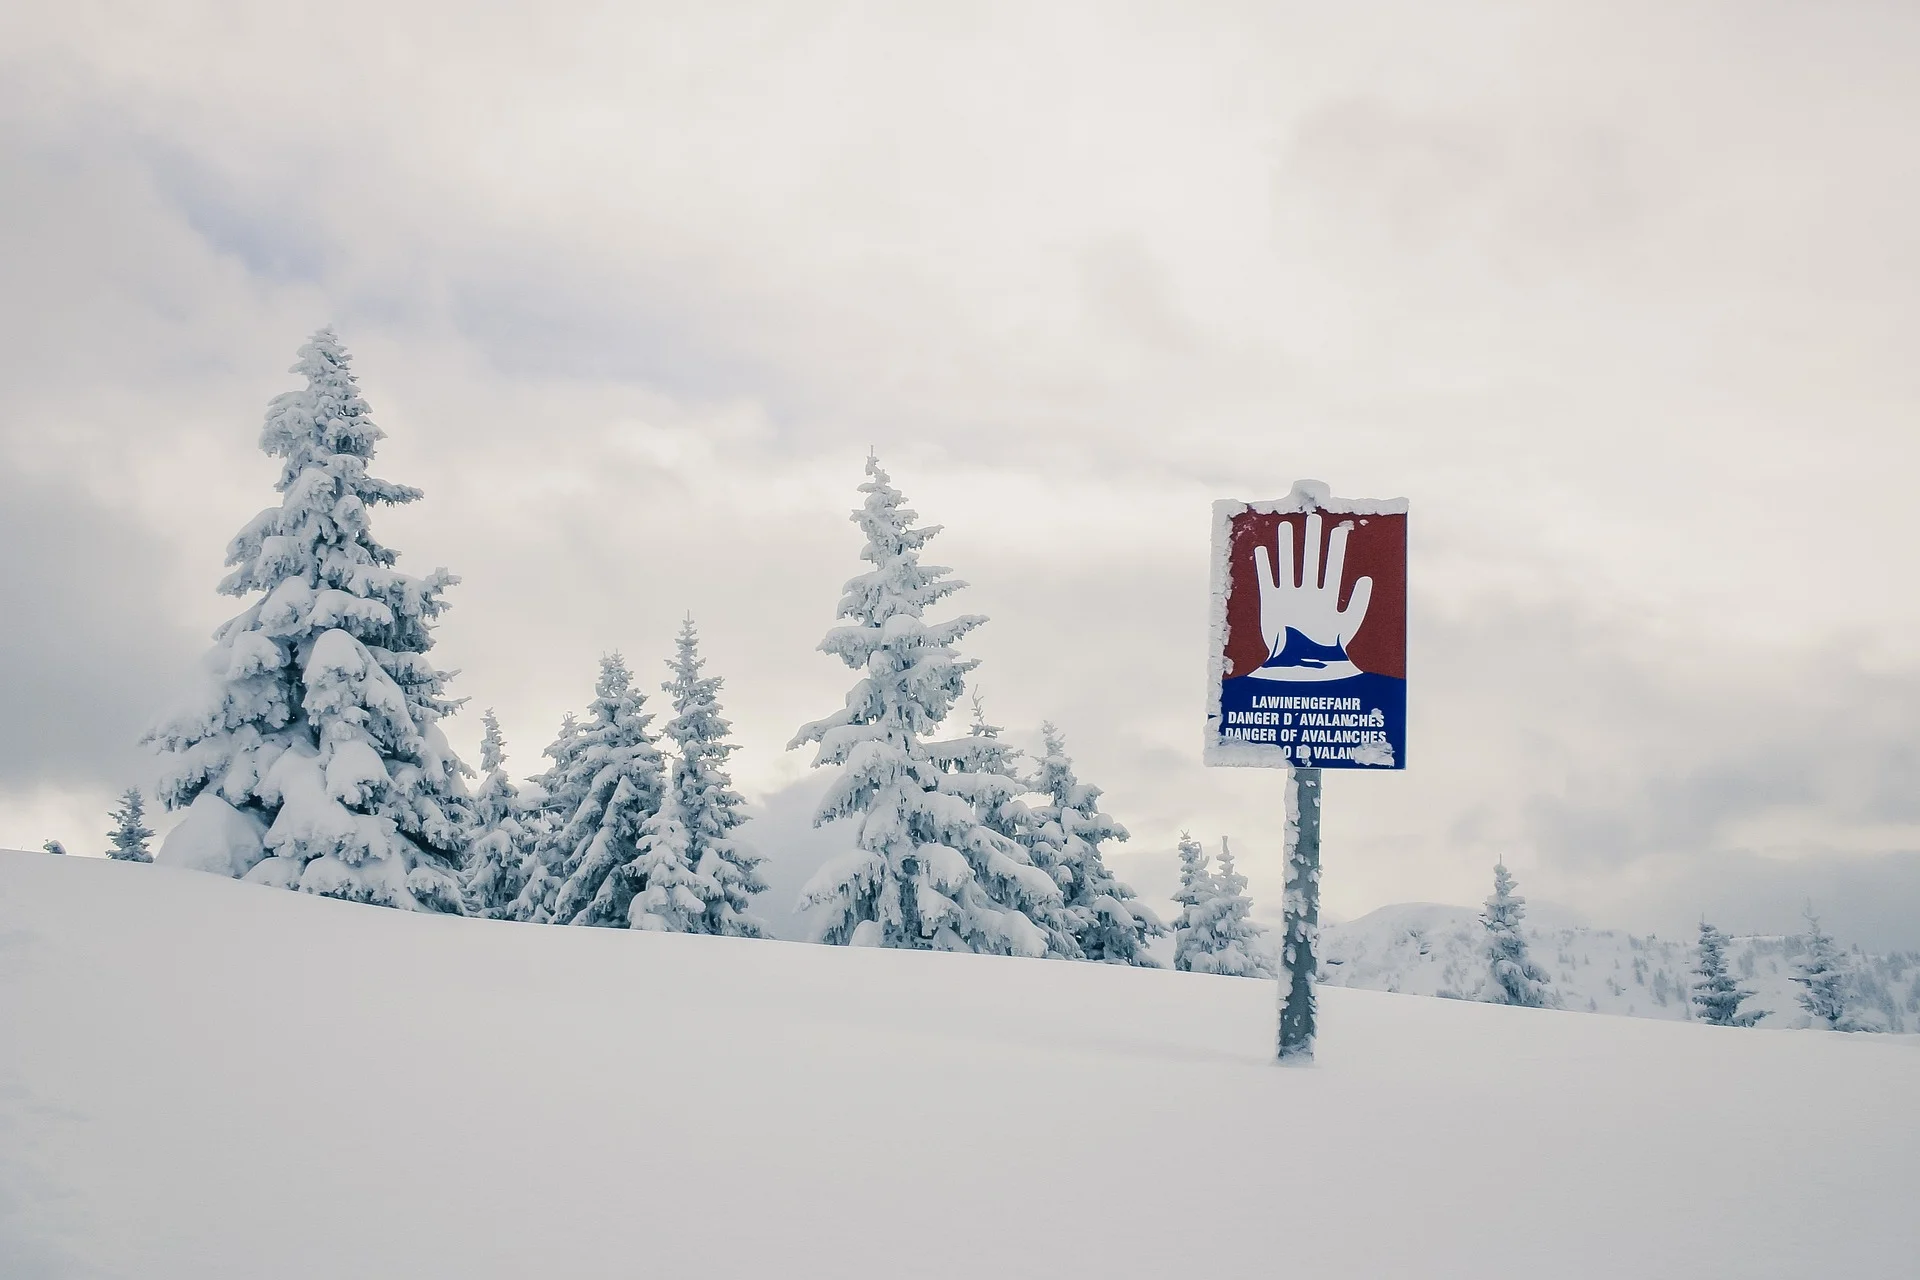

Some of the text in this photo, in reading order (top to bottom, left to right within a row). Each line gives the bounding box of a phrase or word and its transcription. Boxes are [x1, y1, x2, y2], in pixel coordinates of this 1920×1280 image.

[1252, 695, 1361, 710] LAWINENGEFAHR
[1228, 711, 1279, 725] DANGER
[1225, 727, 1387, 744] DANGER OF AVALANCHES
[1314, 746, 1355, 760] VALAN
